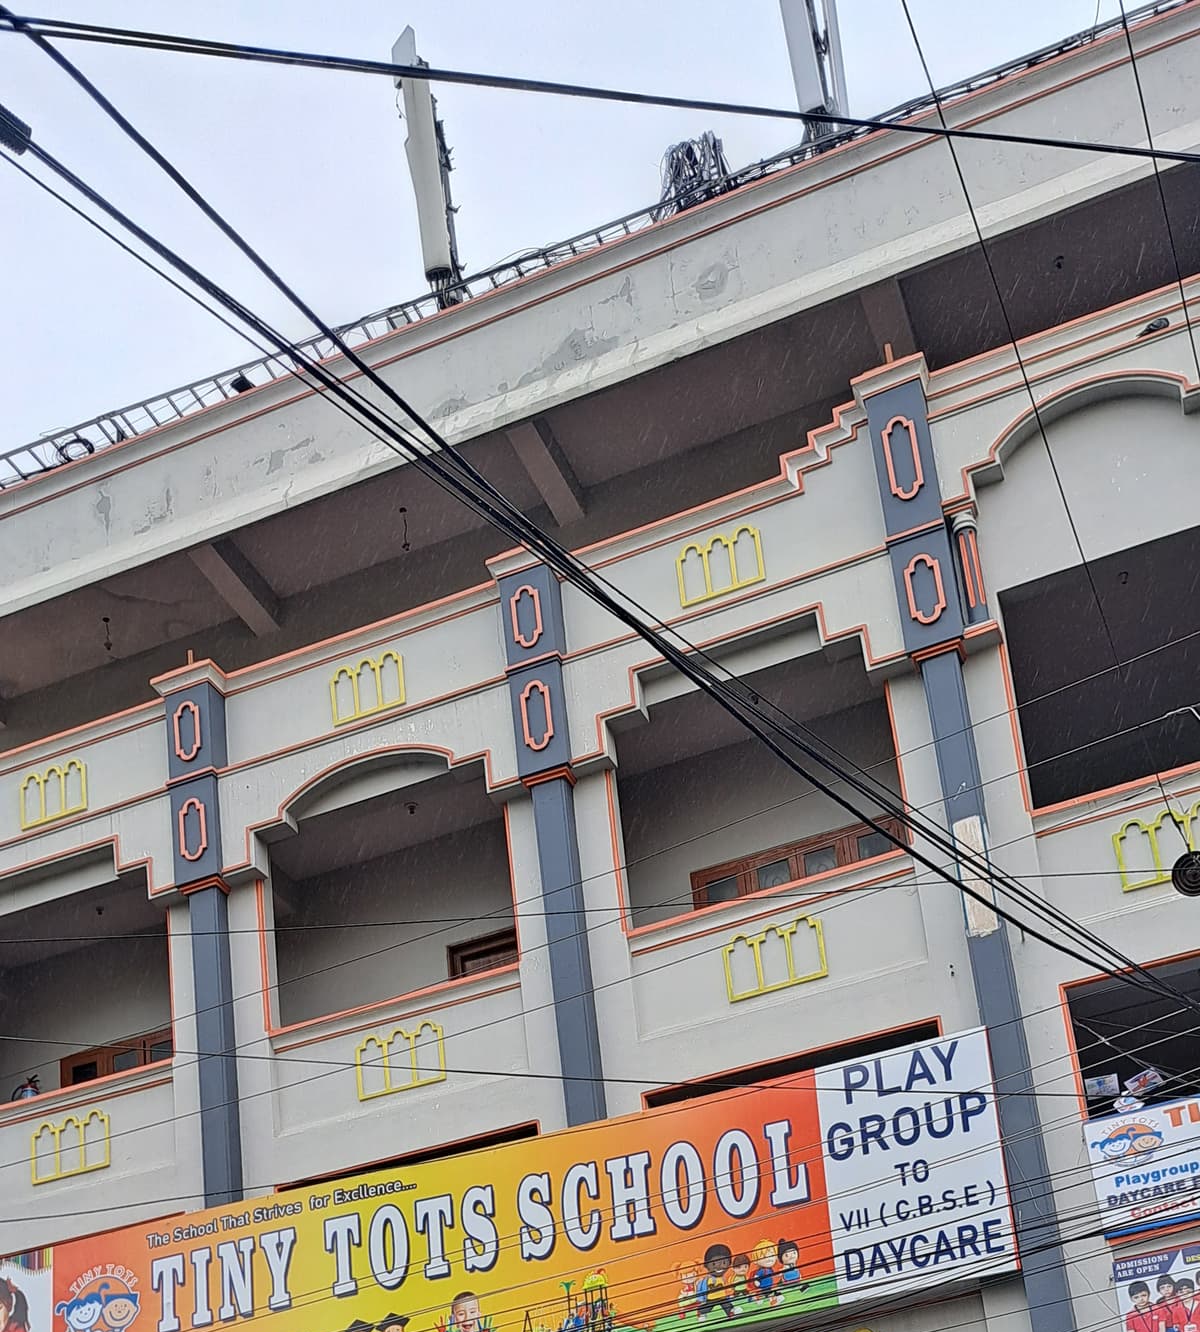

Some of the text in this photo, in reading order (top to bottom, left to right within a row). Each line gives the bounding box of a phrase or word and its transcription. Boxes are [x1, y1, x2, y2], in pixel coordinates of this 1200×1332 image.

[843, 1040, 958, 1104] PLAY
[827, 1092, 986, 1161] GROUP
[1102, 1119, 1126, 1136] TINY
[894, 1159, 929, 1186] TO
[1114, 1161, 1200, 1187] Playgroup
[1107, 1179, 1186, 1207] DAYCARE
[146, 1234, 170, 1249] The
[174, 1219, 218, 1242] School
[220, 1213, 250, 1233] That
[253, 1201, 302, 1223] Strives
[309, 1194, 330, 1210] for
[324, 1184, 499, 1298] TOTS
[517, 1118, 811, 1261] SCHOOL
[839, 1207, 870, 1231] VII
[843, 1218, 1006, 1282] DAYCARE
[1115, 1254, 1169, 1271] ADMISSIONS
[69, 1263, 139, 1294] TINY TOTS
[1117, 1263, 1160, 1279] ARE OPEN
